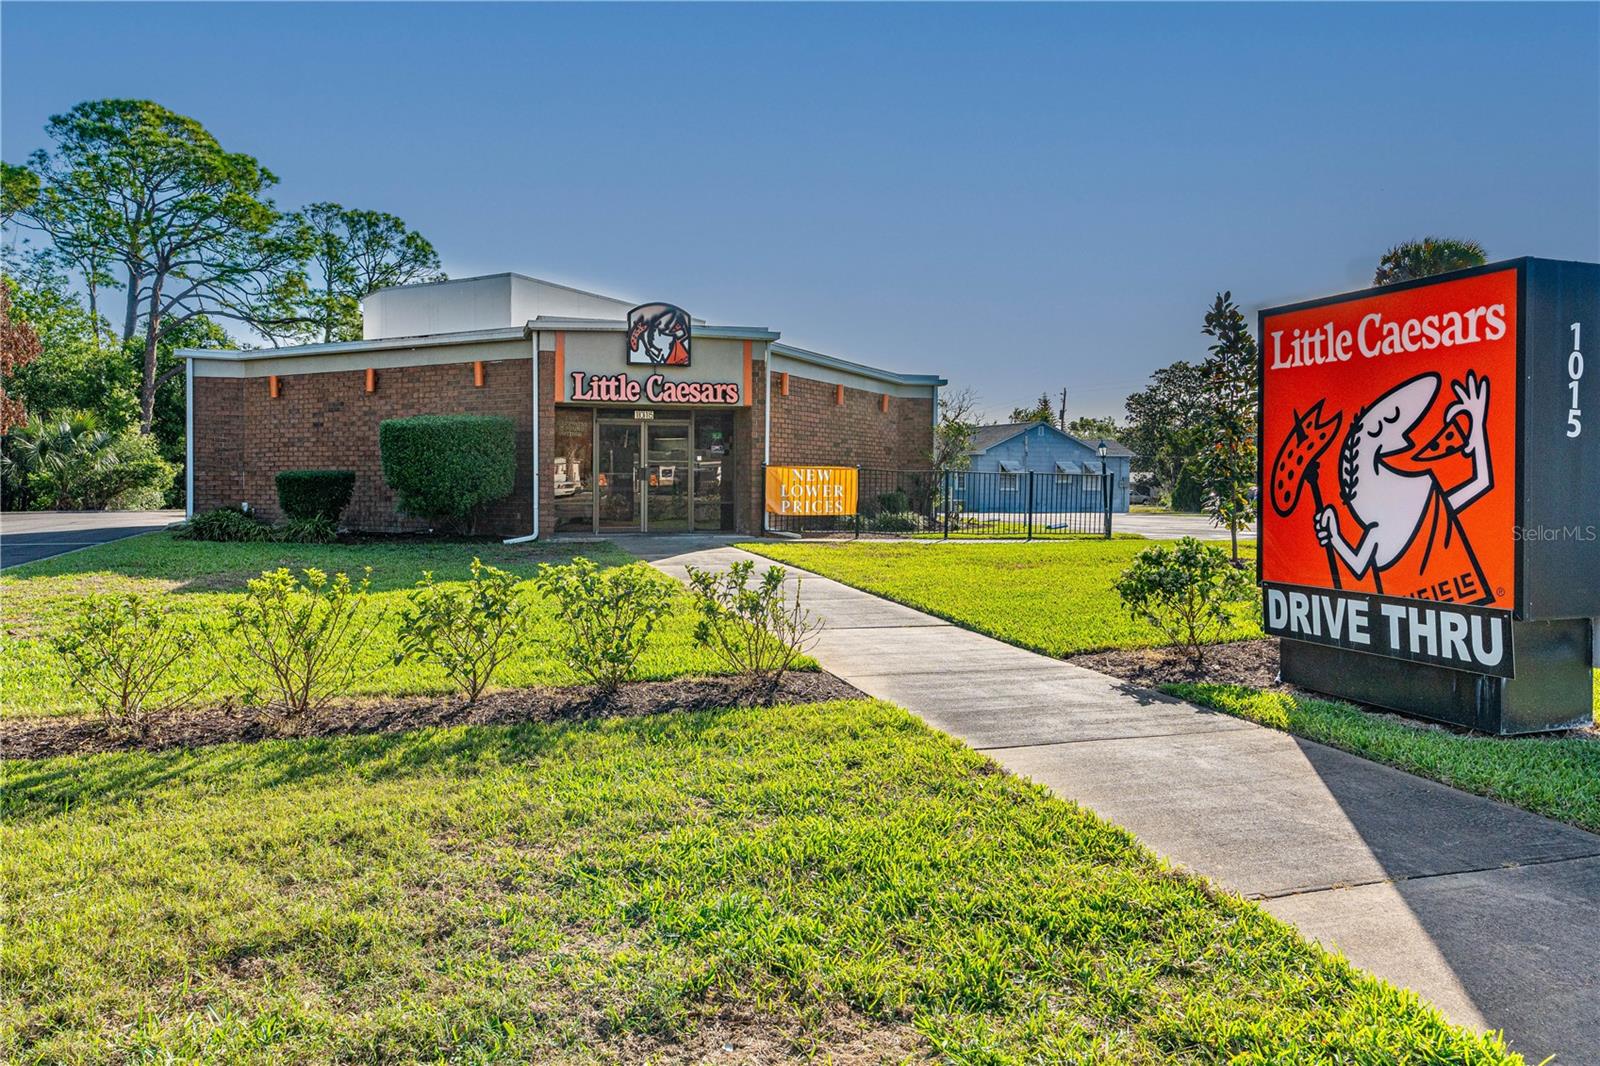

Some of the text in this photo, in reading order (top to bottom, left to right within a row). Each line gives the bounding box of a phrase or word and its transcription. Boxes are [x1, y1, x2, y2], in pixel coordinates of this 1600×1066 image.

[1271, 304, 1507, 370] Little Caesars
[572, 372, 740, 403] Little Caesars
[1566, 322, 1584, 438] 1015
[781, 484, 843, 497] LOWER
[792, 469, 832, 481] NEW
[781, 500, 843, 513] PRICES
[1267, 588, 1504, 666] DRIVE THRU
